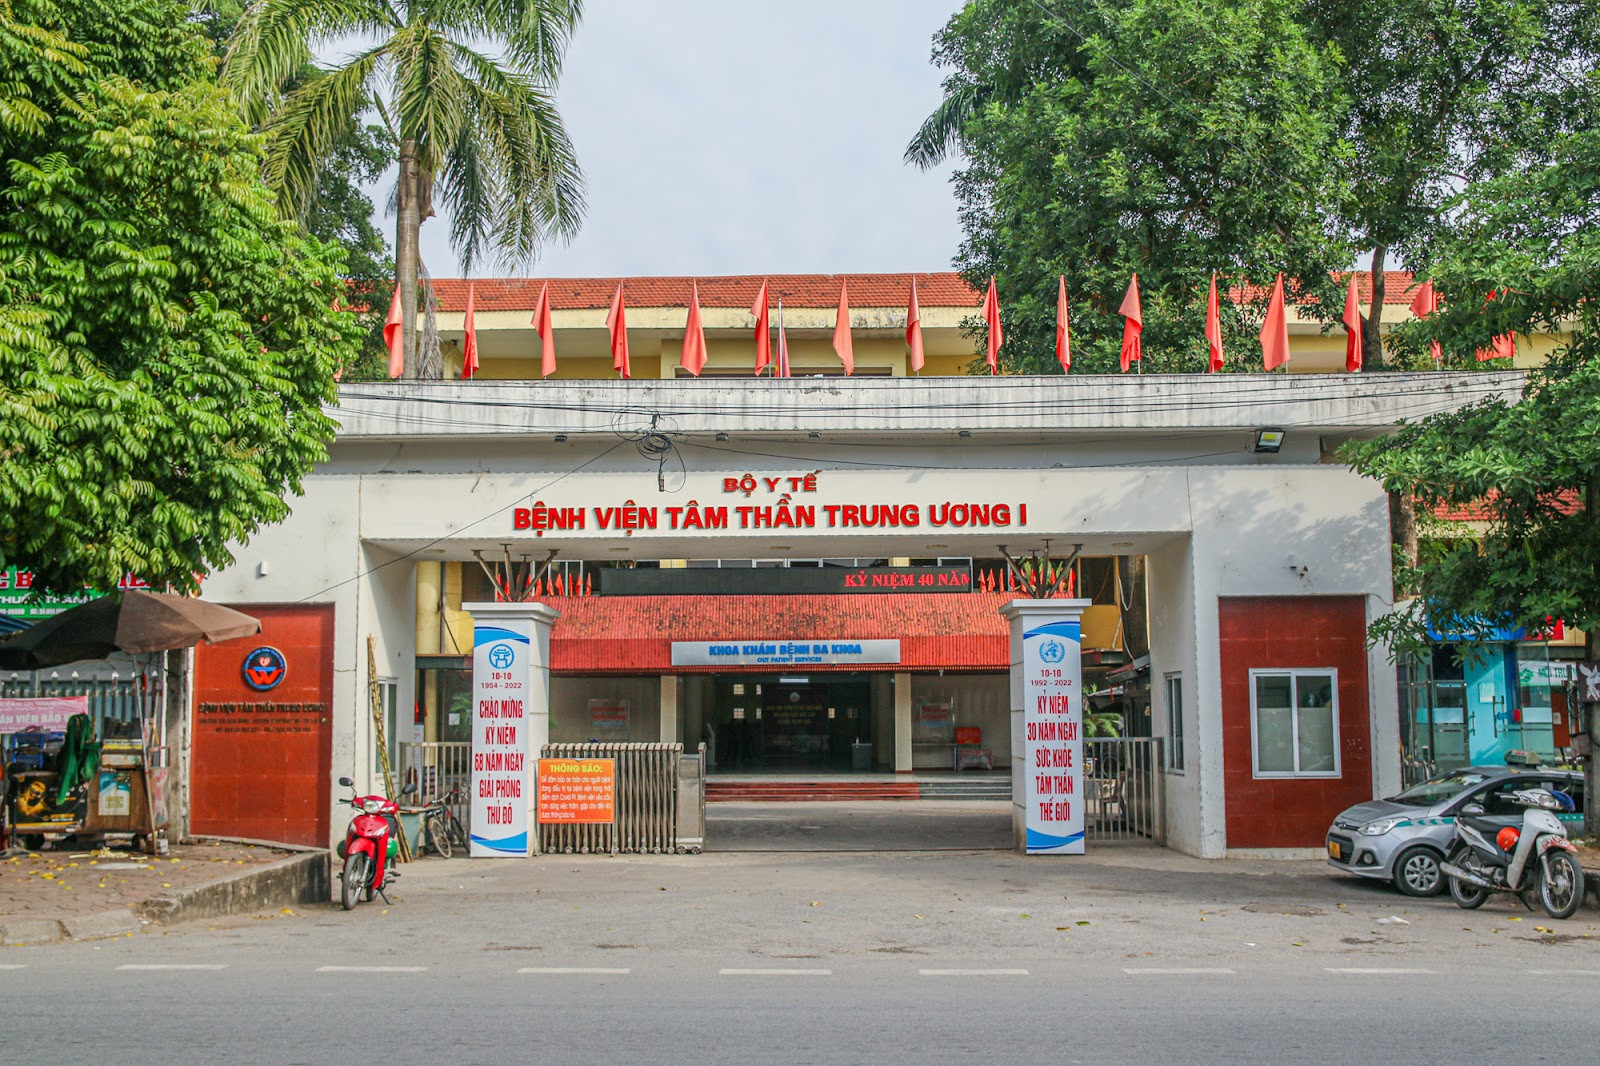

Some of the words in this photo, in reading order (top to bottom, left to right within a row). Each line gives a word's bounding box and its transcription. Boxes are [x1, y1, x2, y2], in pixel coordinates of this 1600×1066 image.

[724, 473, 757, 497] BỘ
[763, 477, 781, 492] Y
[788, 470, 822, 493] TẾ
[513, 501, 585, 537] BỆNH
[593, 500, 657, 536] VIỆN
[666, 500, 728, 529] TÂM
[736, 493, 815, 528] THẦN
[824, 504, 920, 527] TRUNG
[929, 501, 1011, 527] ƯƠNG
[1020, 503, 1027, 526] I
[844, 570, 868, 587] KỶ
[872, 571, 915, 590] NIỆM
[918, 574, 934, 586] 40
[709, 645, 739, 656] KHOA
[743, 642, 776, 655] KHÁM
[780, 642, 810, 657] BỆNH
[832, 644, 862, 654] KHOA
[492, 672, 512, 680] 10-10
[1041, 669, 1061, 677] 10-10
[479, 695, 499, 718] CHÀO
[501, 695, 523, 718] MỪNG
[1037, 689, 1047, 714] KỶ
[1049, 691, 1069, 718] NIỆM
[485, 720, 495, 745] KỶ
[497, 722, 516, 749] NIỆM
[1027, 722, 1037, 741] 30
[1038, 718, 1056, 741] NĂM
[1058, 718, 1078, 741] NGÀY
[474, 753, 484, 771] 68
[486, 749, 503, 771] NĂM
[504, 749, 524, 771] NGÀY
[550, 763, 580, 772] THÔNG
[582, 763, 603, 772] BÁO:
[1036, 744, 1051, 768] SỨC
[1053, 742, 1073, 768] KHỎE
[479, 773, 494, 798] GIẢI
[496, 775, 521, 798] PHÓNG
[1036, 771, 1052, 795] TÂM
[1054, 769, 1073, 795] THẦN
[487, 800, 501, 825] THỦ
[1040, 796, 1053, 821] THẾ
[1055, 798, 1070, 821] GIỚI
